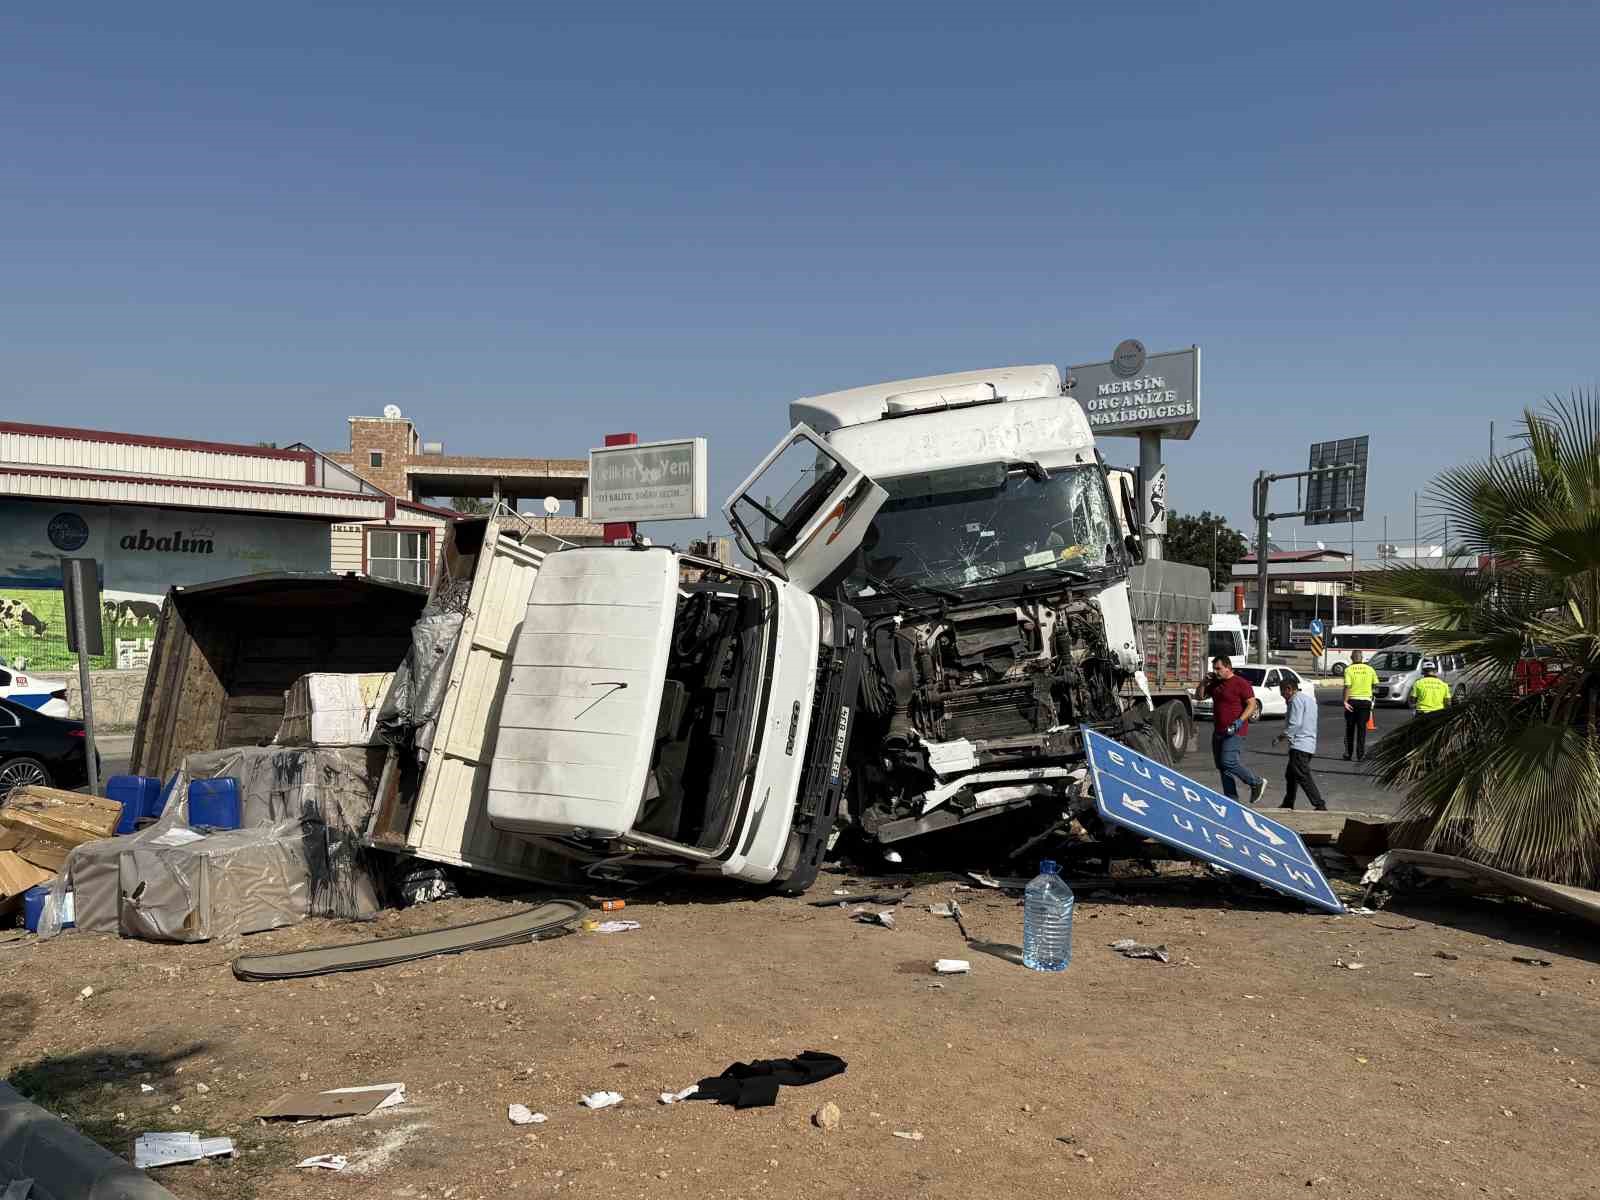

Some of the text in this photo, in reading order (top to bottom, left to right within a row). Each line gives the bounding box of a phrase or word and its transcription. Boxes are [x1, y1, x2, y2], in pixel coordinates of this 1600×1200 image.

[1098, 376, 1166, 395] MERSİN
[1087, 390, 1177, 411] ORGANİZE
[660, 459, 690, 476] Yem
[1108, 750, 1228, 819] Adana
[1172, 814, 1315, 889] Mersin
